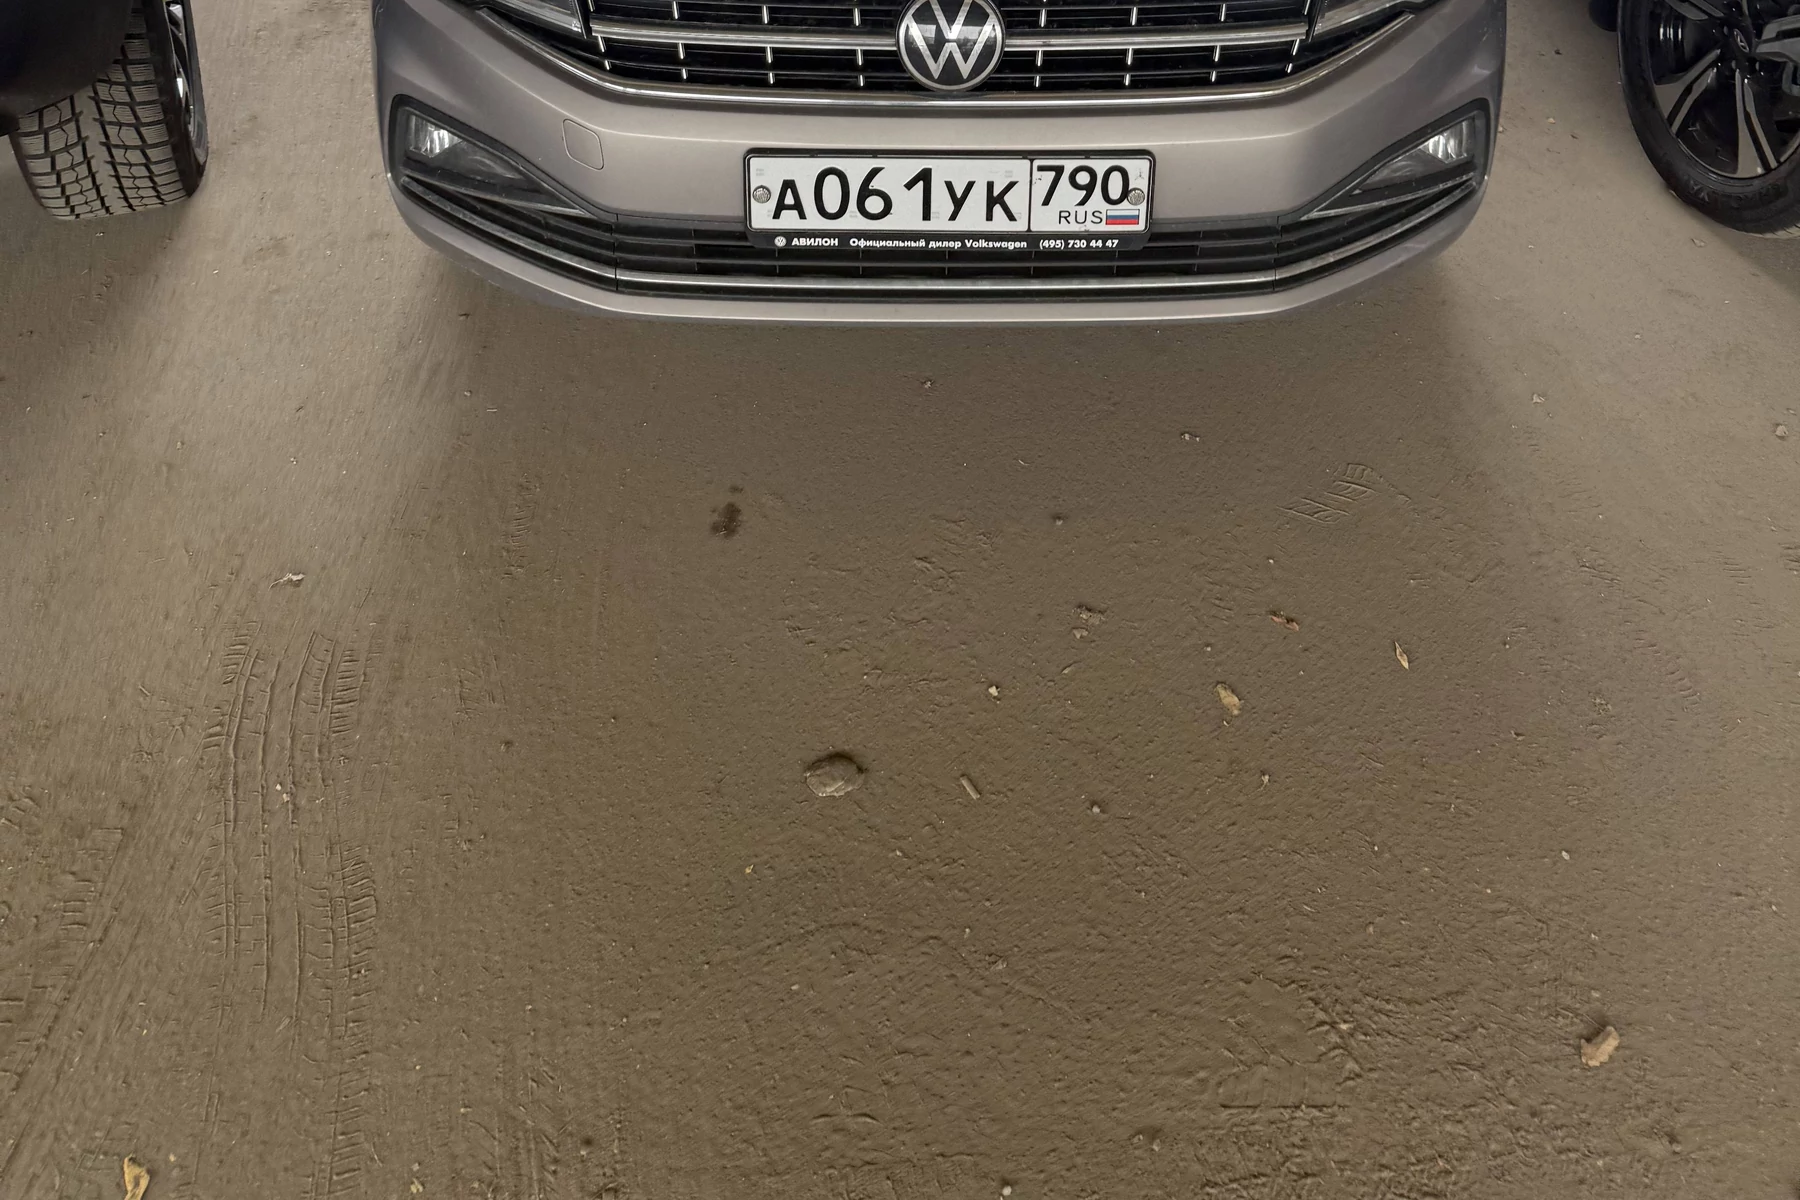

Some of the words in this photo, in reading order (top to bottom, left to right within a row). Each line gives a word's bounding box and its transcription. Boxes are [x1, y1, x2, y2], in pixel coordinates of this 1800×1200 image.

[1036, 164, 1130, 207] 790
[1058, 210, 1103, 225] RUS
[791, 237, 839, 246] АВИЛОН
[849, 238, 926, 249] Официальный
[928, 240, 962, 249] дилер
[964, 239, 1027, 250] Volkswagen
[1039, 239, 1065, 250] (495)
[1067, 239, 1087, 248] 730
[1089, 239, 1103, 248] 44
[1105, 239, 1119, 248] 47
